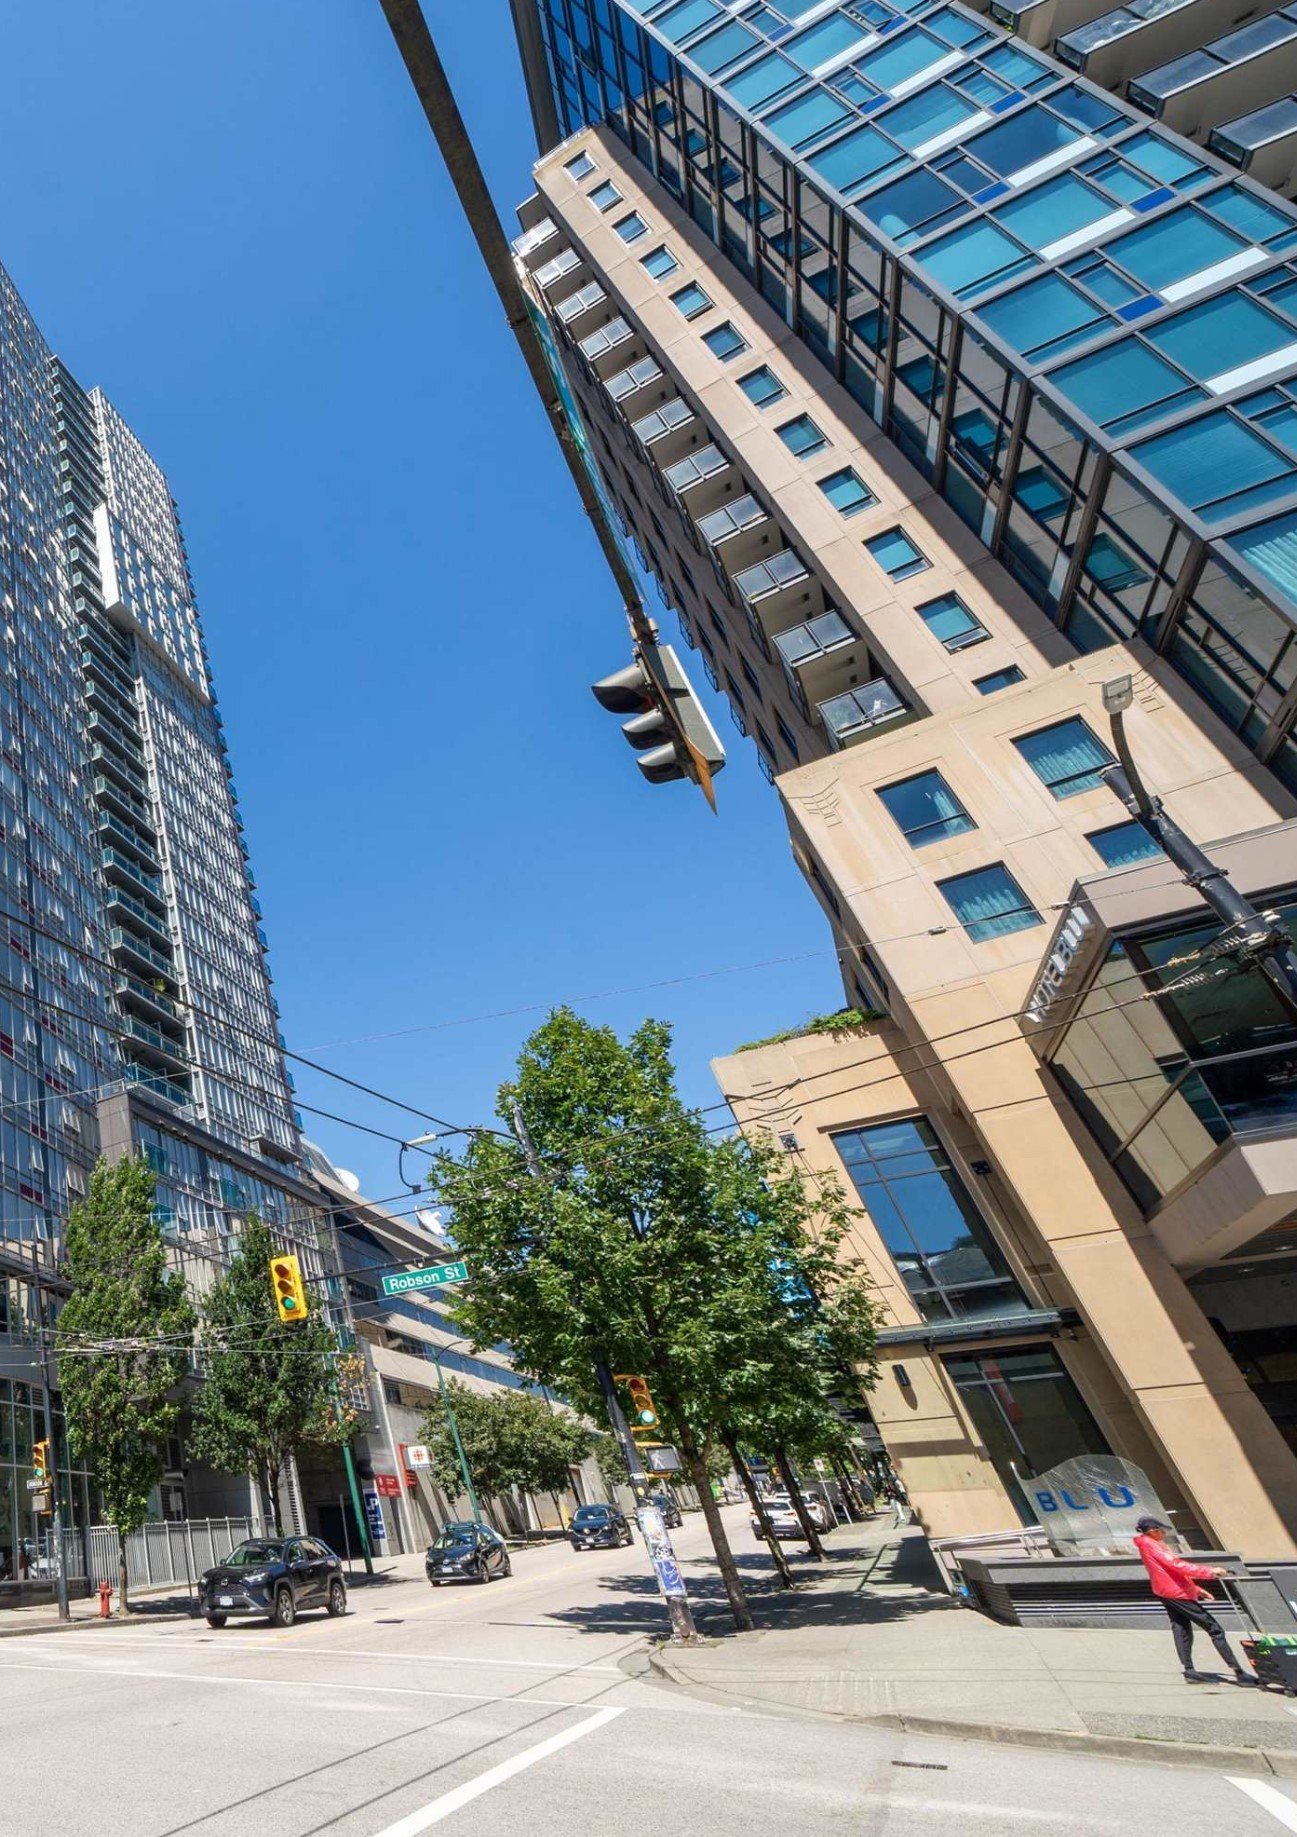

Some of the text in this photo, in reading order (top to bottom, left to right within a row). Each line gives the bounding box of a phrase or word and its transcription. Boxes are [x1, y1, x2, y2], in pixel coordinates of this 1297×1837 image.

[389, 1266, 461, 1291] Robson St
[1035, 1485, 1135, 1512] BLU
